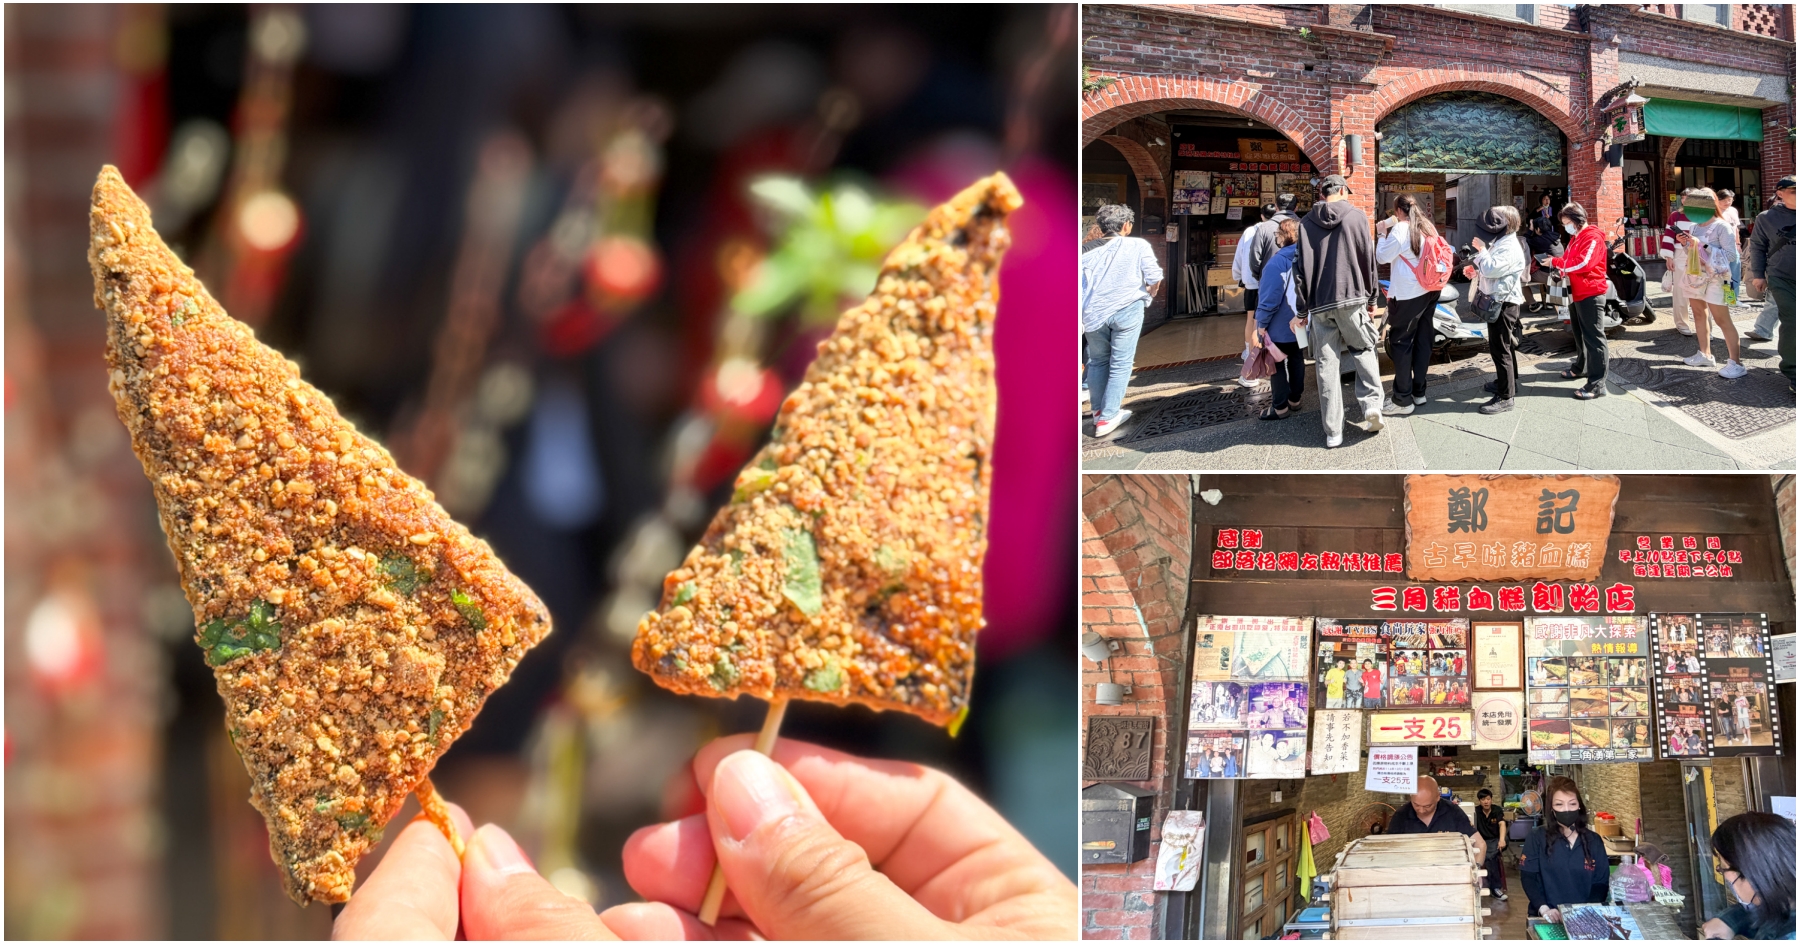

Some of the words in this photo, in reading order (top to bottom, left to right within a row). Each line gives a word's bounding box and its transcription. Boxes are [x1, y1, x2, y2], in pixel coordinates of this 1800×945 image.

[1447, 486, 1580, 534] 鄭記
[1217, 528, 1263, 549] 感謝
[1212, 550, 1403, 573] 部落格網友熱情推薦
[1423, 541, 1592, 568] 古早味豬血糕
[1618, 550, 1742, 564] 早上10點至下午6點
[1633, 564, 1733, 578] 每逢星期二公休
[1370, 582, 1635, 612] 三角豬血糕創始店
[1534, 624, 1637, 639] 感謝非凡大探索
